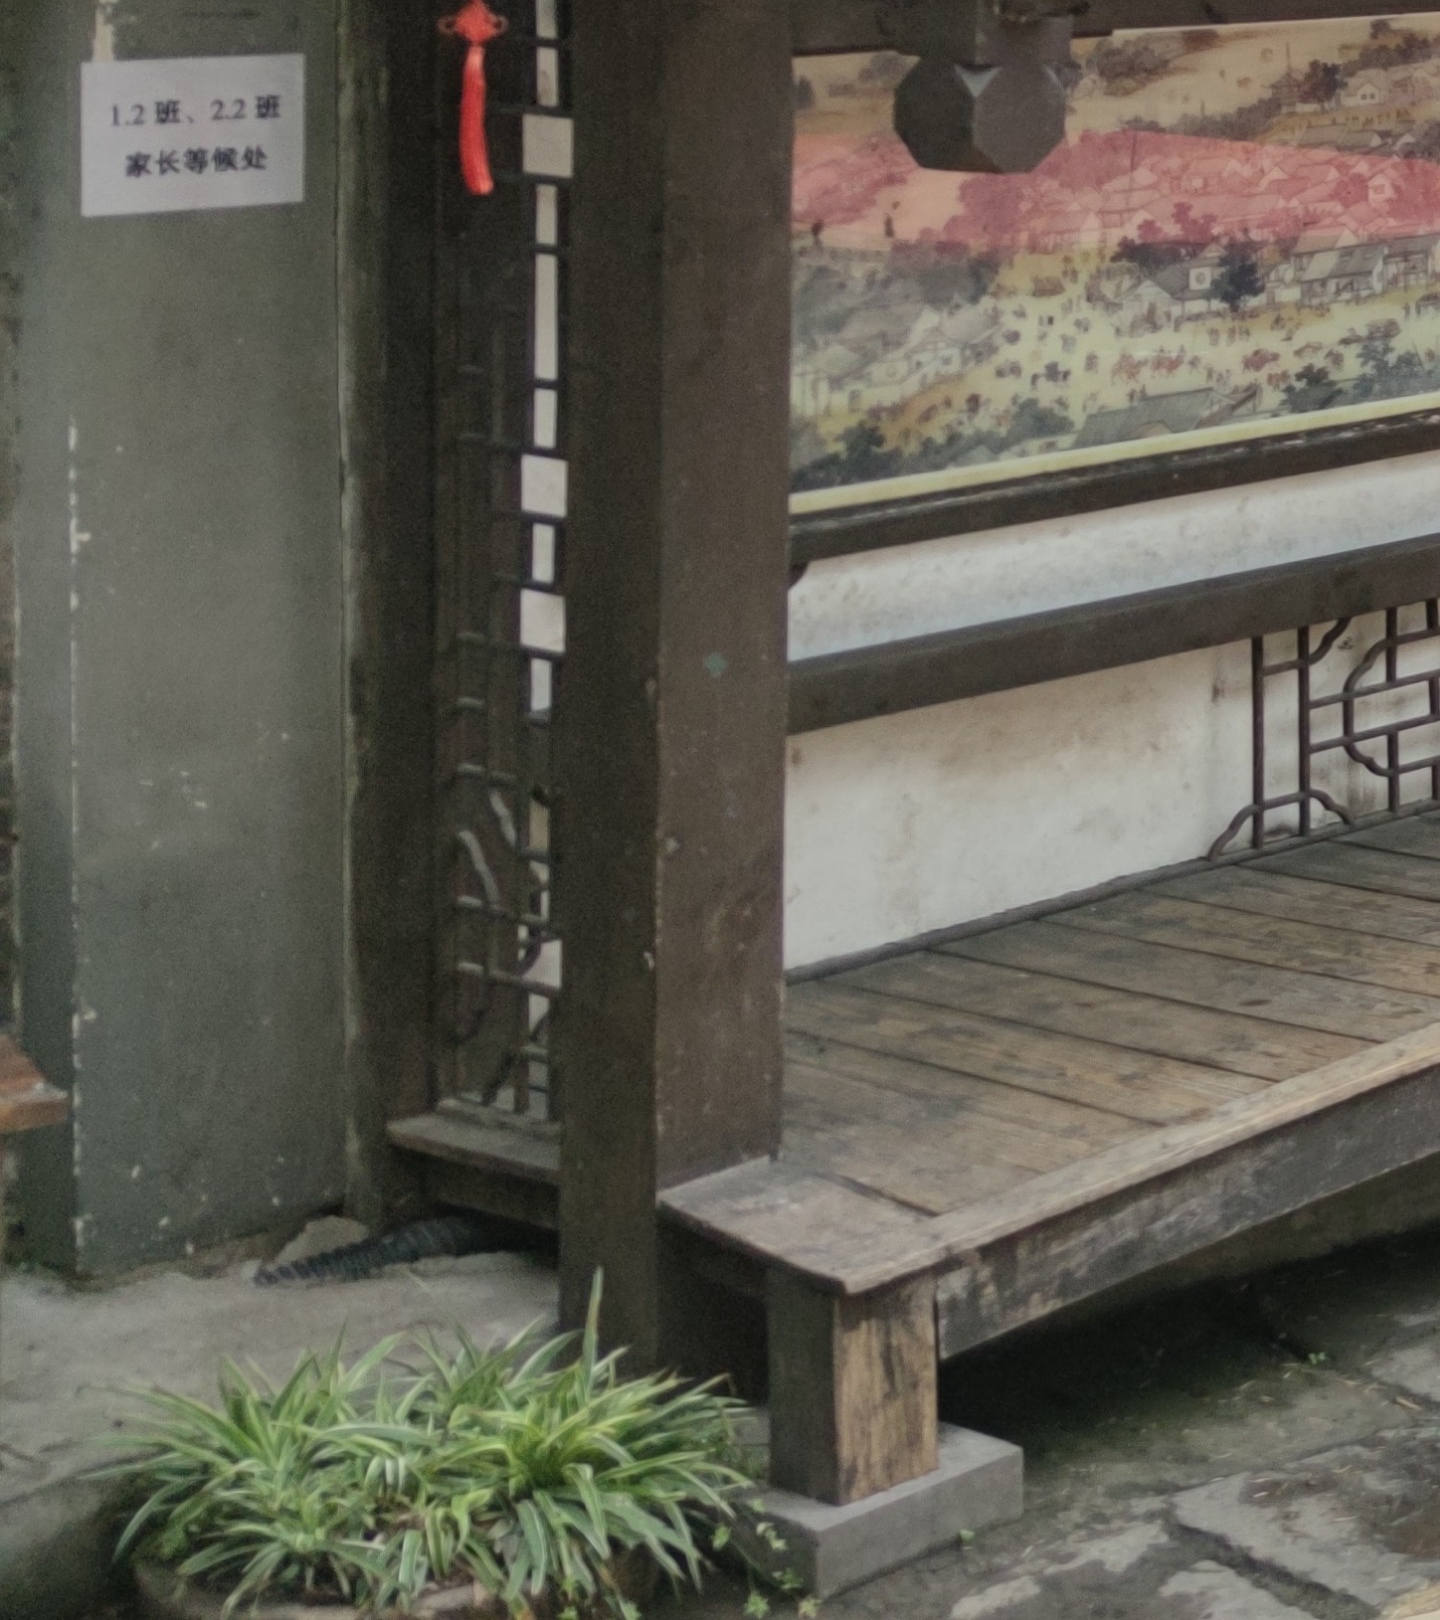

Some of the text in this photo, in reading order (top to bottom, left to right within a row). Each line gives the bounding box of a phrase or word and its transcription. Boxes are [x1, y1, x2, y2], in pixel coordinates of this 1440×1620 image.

[126, 145, 268, 178] 家长等候处
